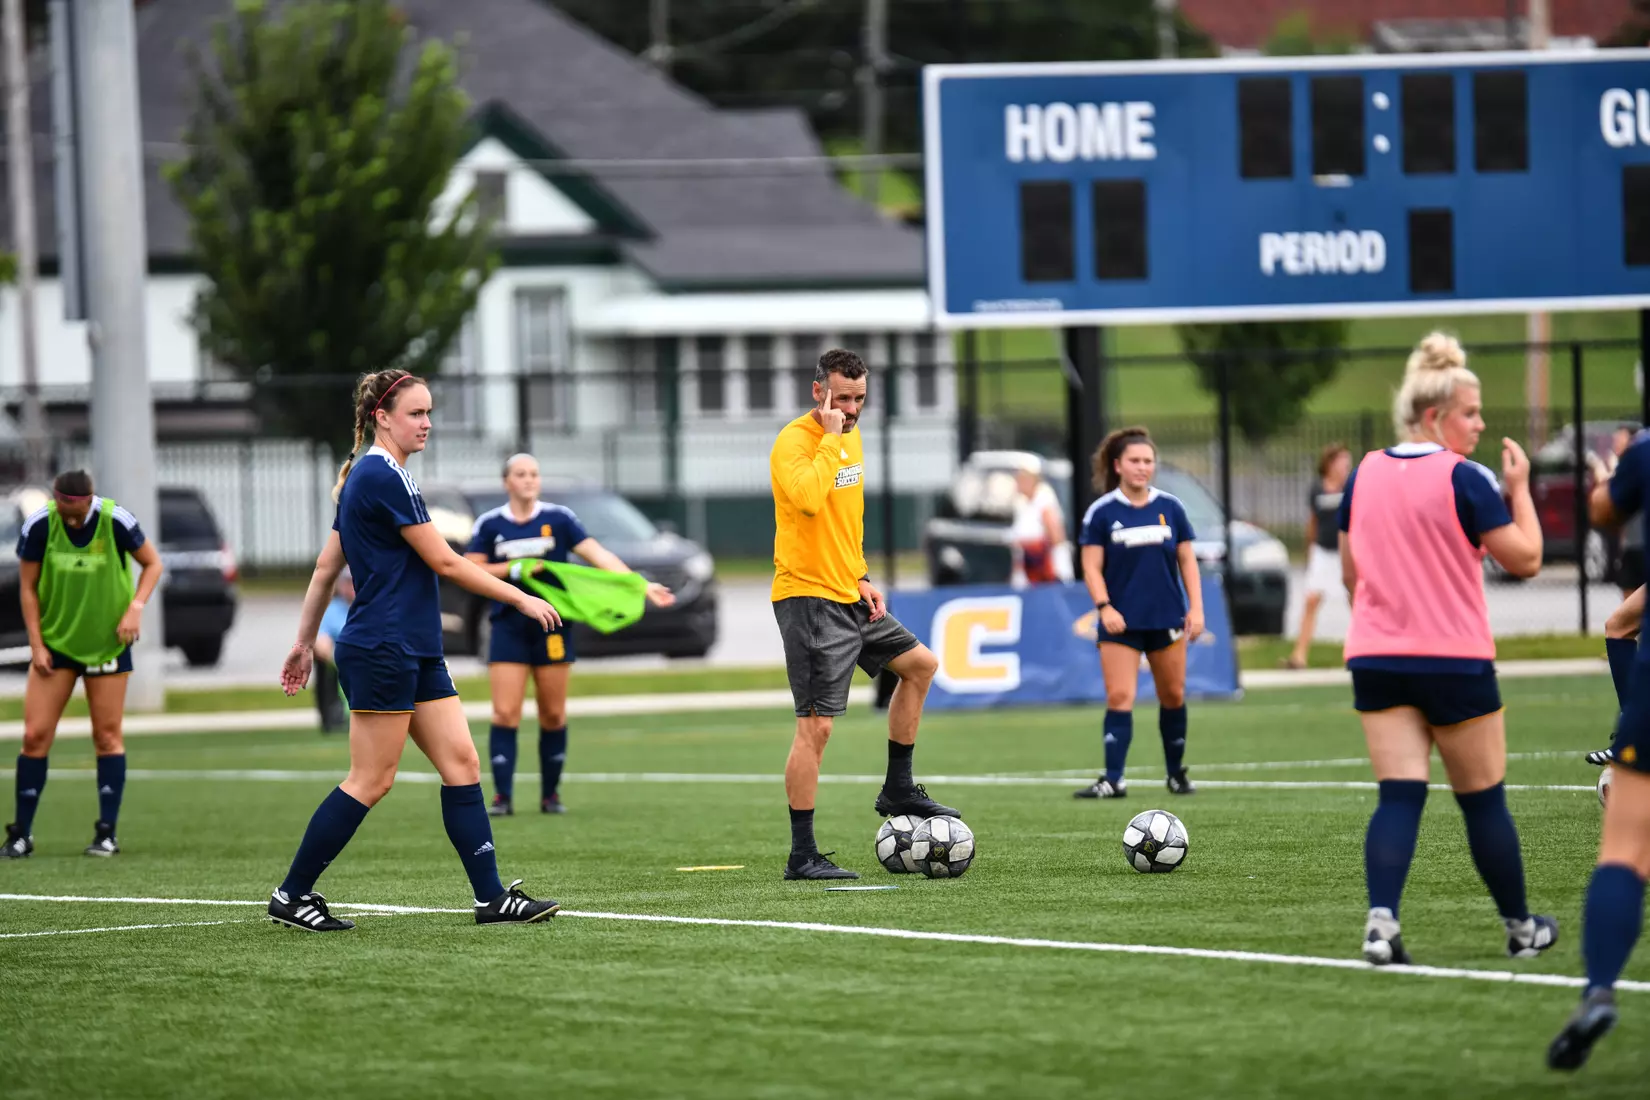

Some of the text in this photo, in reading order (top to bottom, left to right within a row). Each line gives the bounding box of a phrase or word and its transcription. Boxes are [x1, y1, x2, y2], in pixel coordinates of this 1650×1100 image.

[1004, 101, 1157, 162] HOME
[1259, 230, 1387, 275] PERIOD
[931, 595, 1022, 693] C
